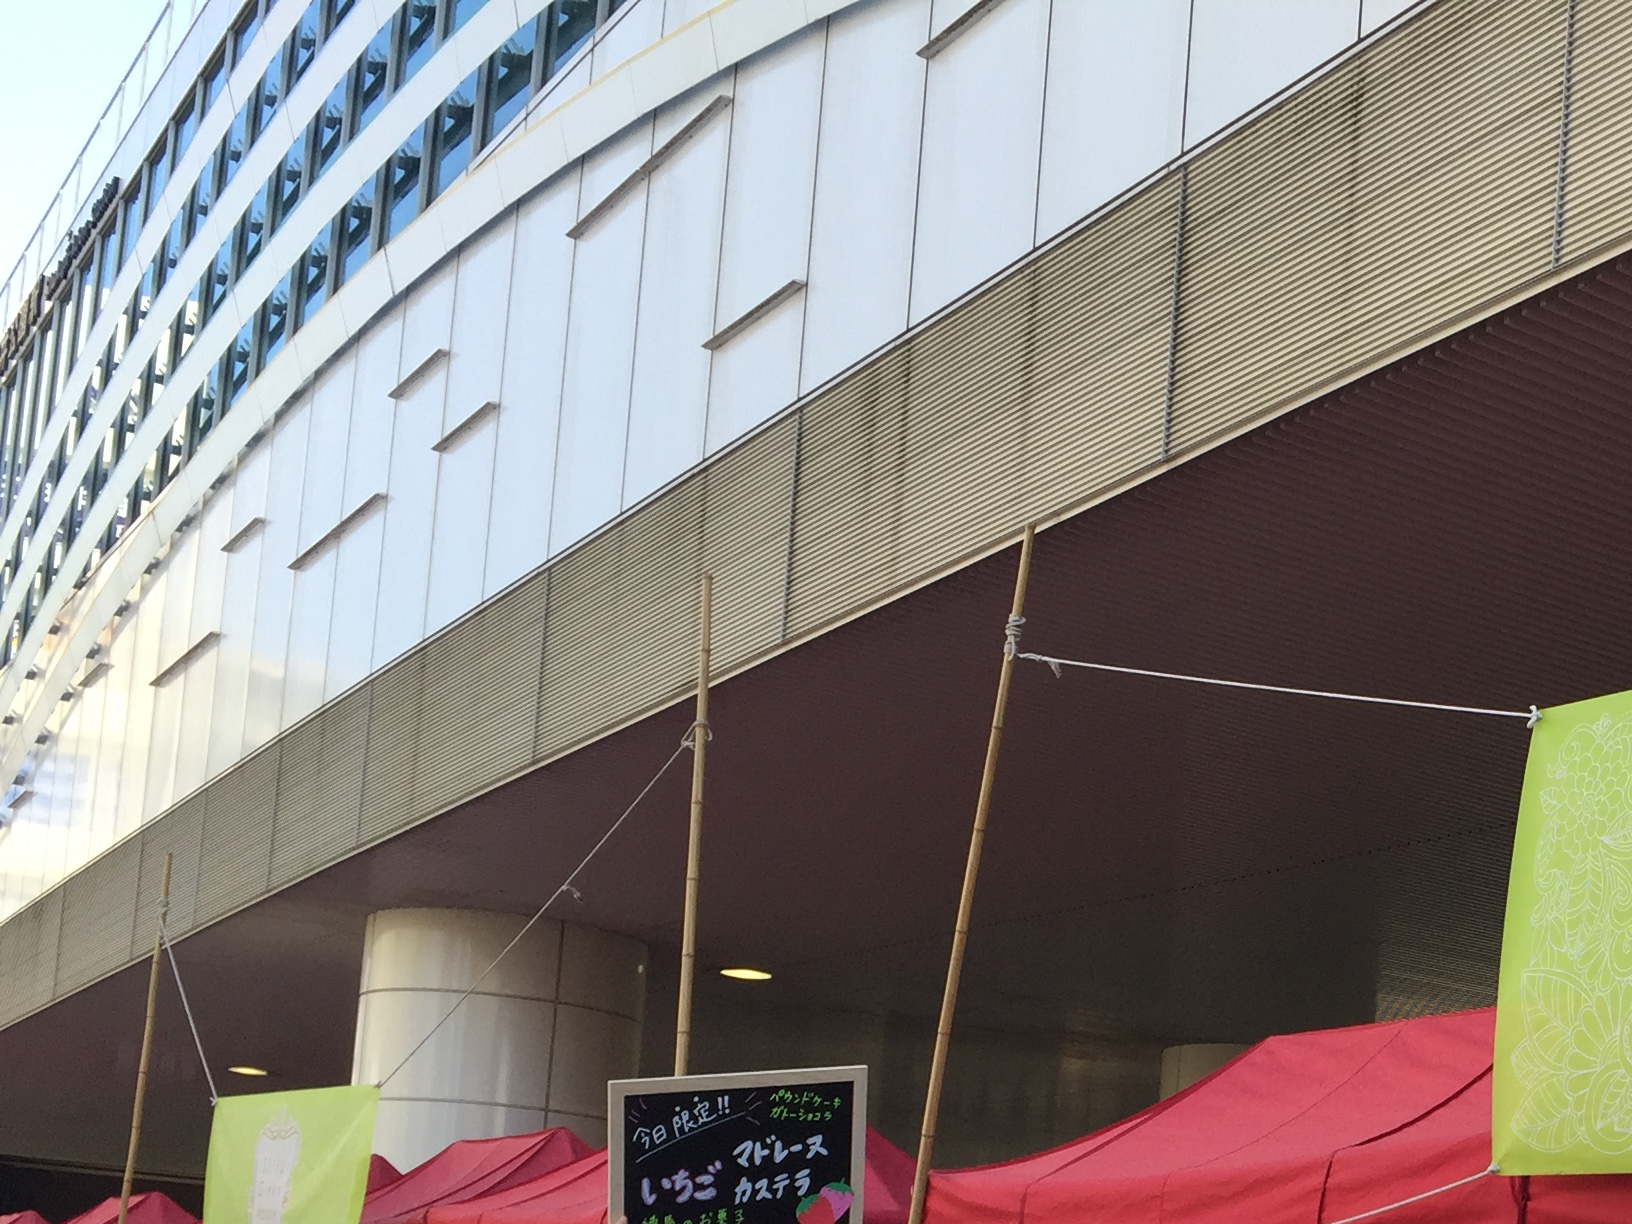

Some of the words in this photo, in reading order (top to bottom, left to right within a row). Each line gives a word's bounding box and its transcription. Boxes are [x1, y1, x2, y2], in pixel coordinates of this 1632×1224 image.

[732, 1134, 829, 1168] マドレーヌ
[640, 1160, 723, 1206] いちご
[733, 1168, 812, 1206] カステラ
